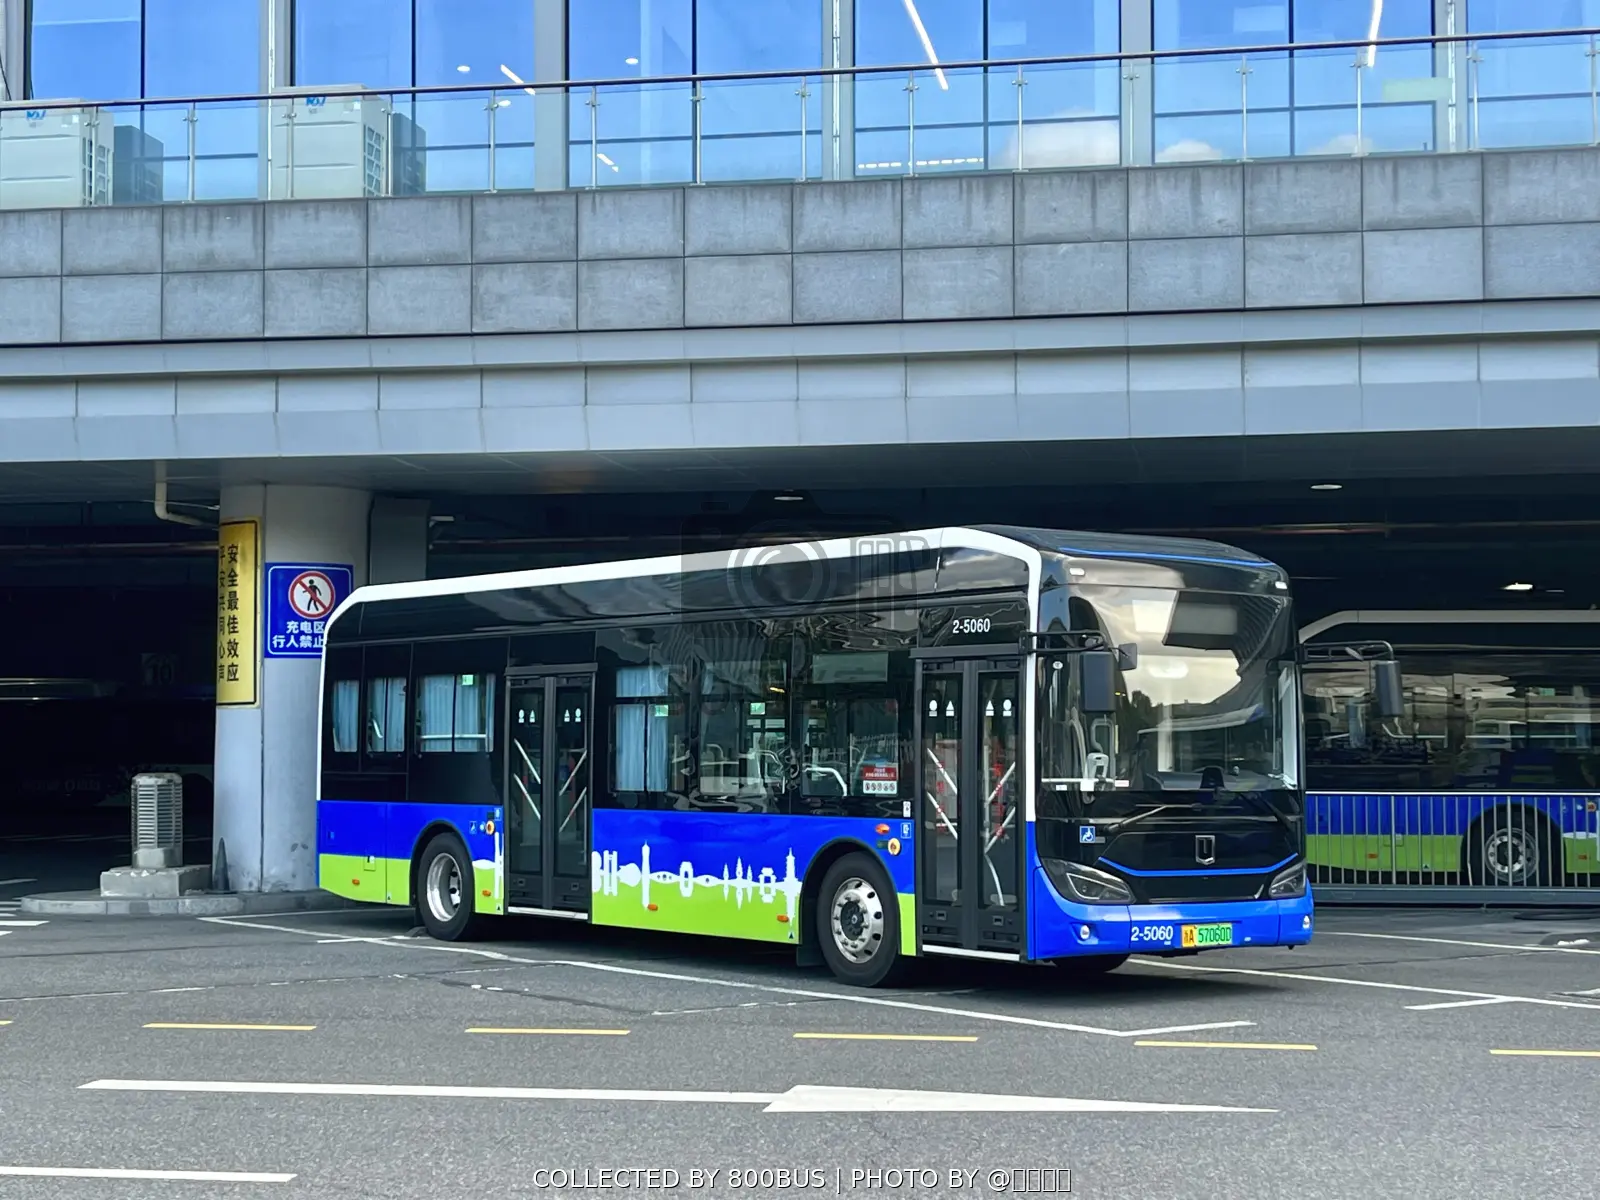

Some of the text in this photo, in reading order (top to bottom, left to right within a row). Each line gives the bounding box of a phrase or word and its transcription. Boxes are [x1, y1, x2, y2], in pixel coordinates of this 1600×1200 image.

[227, 544, 239, 683] 安全最佳效应
[286, 620, 325, 634] 充电区
[952, 617, 991, 634] 2-5060
[1131, 925, 1174, 941] 2-5060
